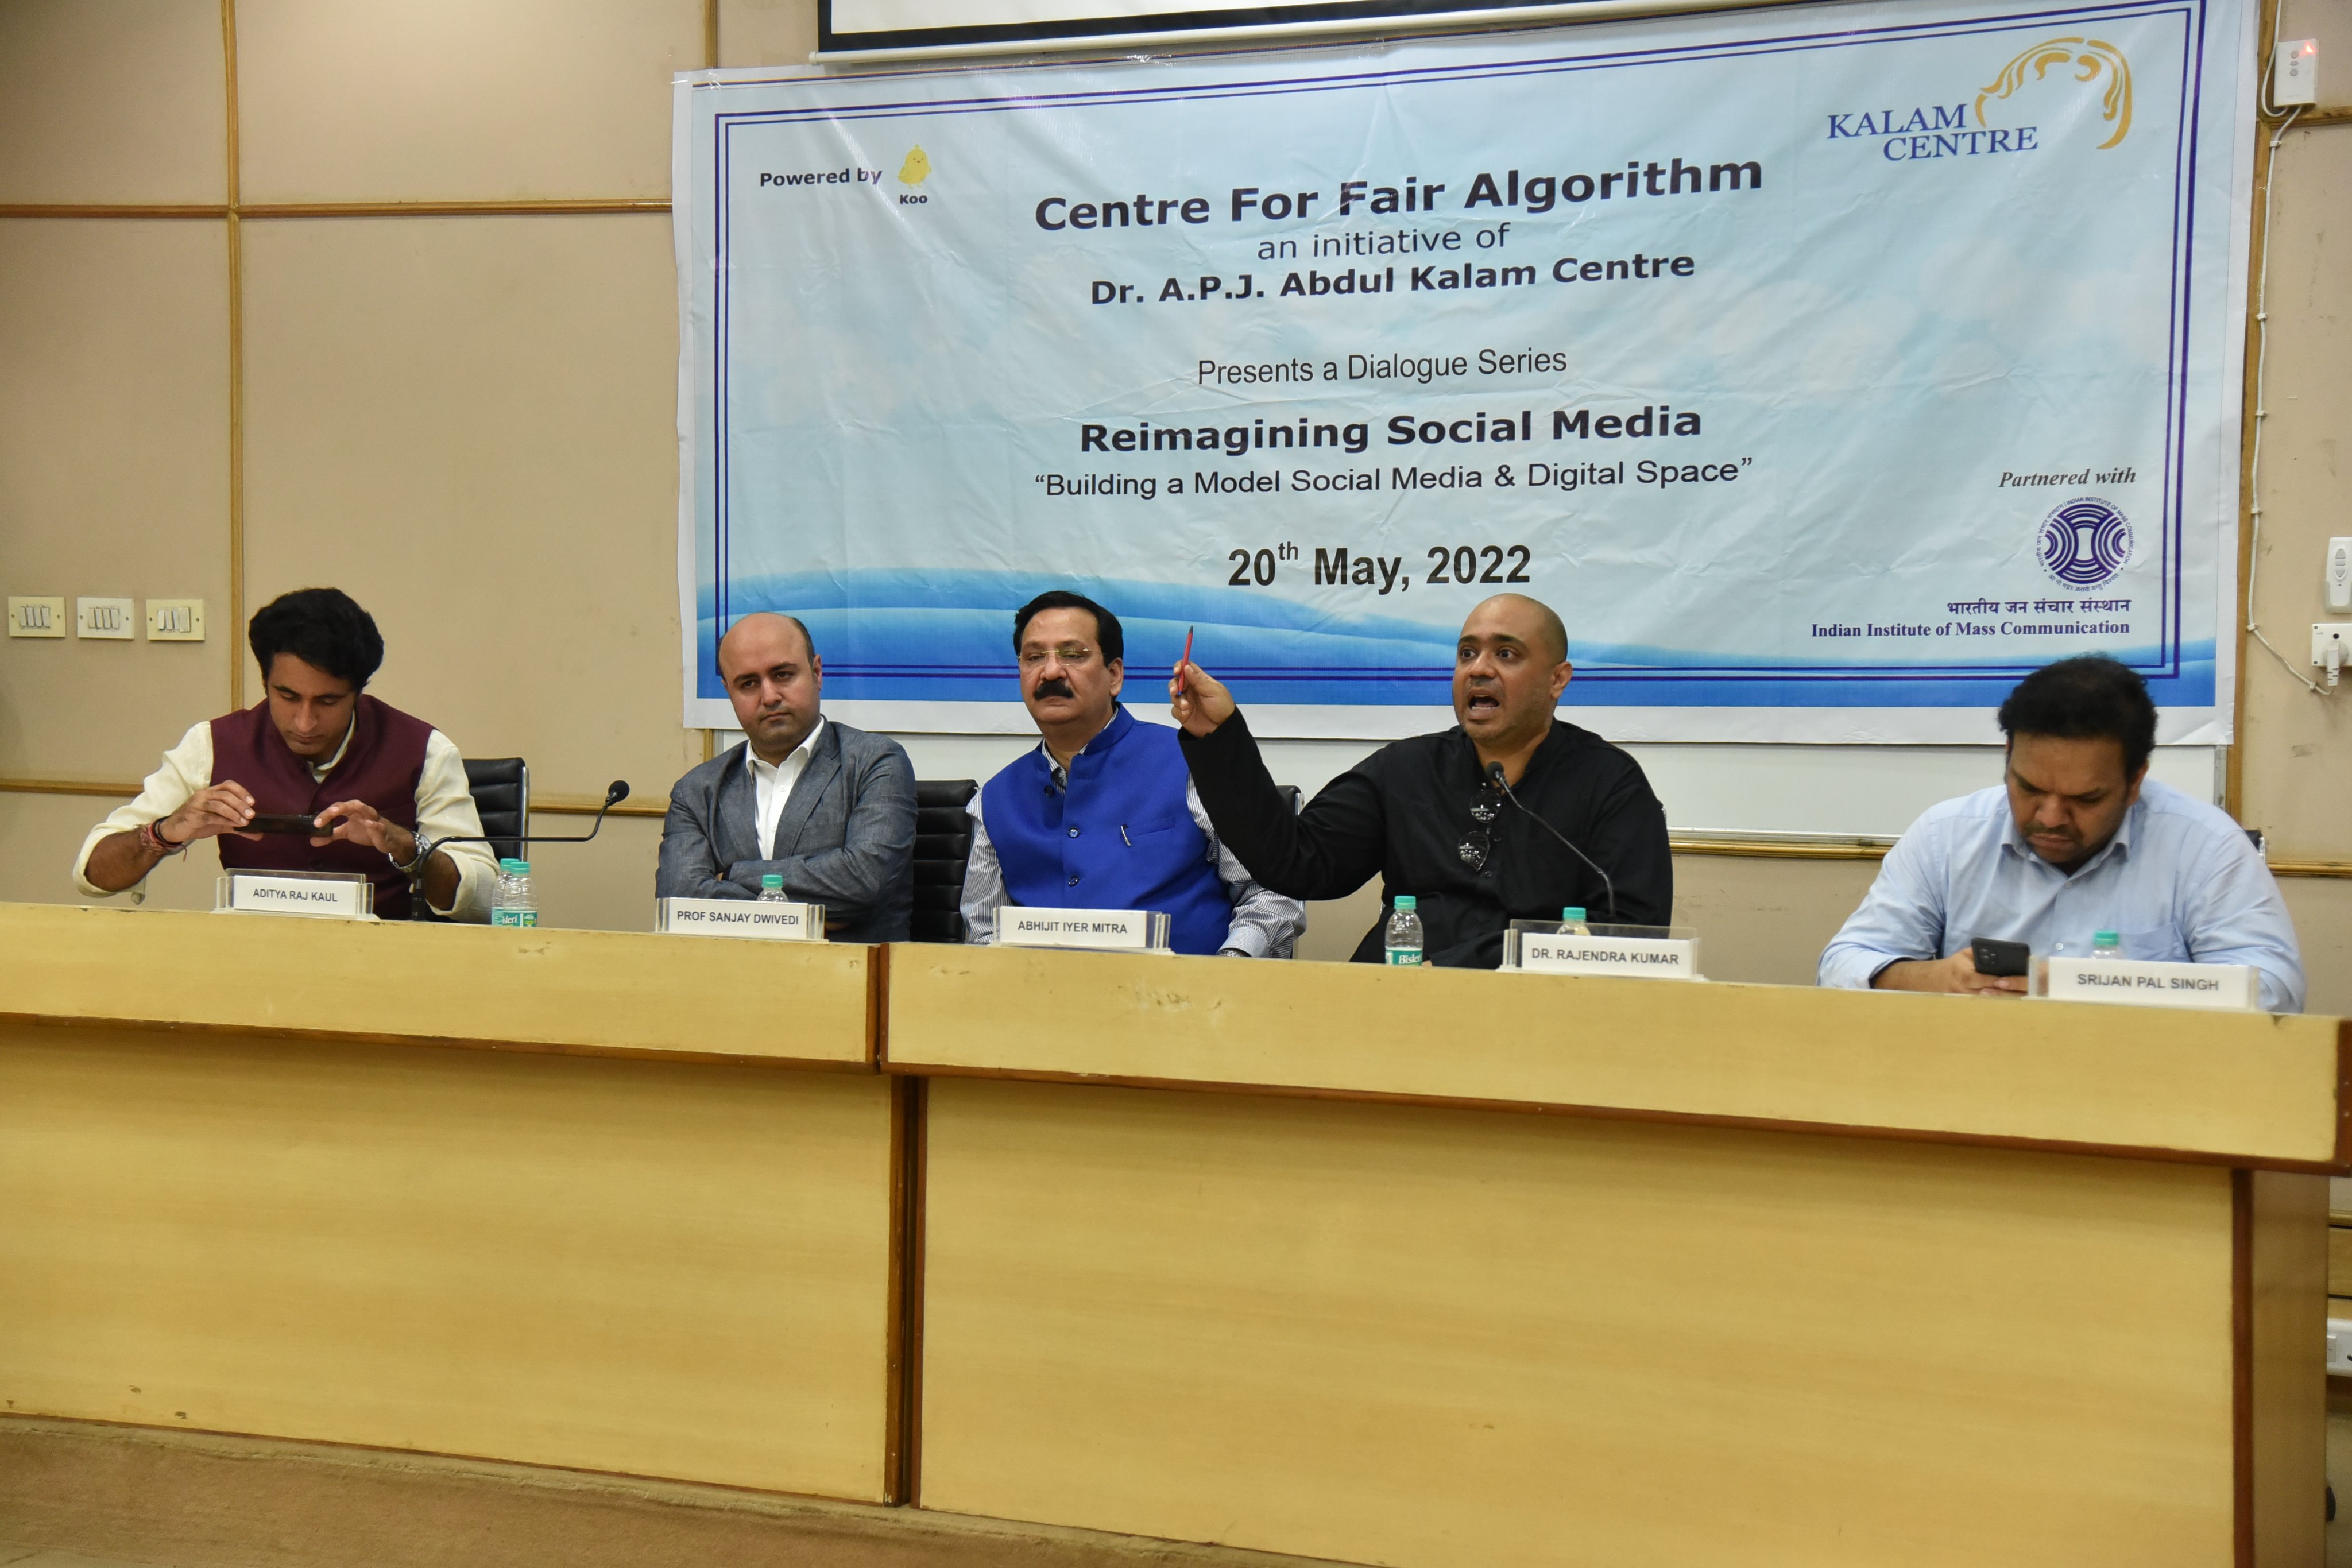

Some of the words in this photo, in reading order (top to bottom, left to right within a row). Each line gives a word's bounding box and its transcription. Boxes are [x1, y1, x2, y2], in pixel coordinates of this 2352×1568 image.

[1827, 103, 1967, 139] KALAM
[1883, 126, 2038, 161] CENTRE
[761, 168, 849, 187] Powered
[857, 168, 882, 184] by
[900, 195, 927, 204] Koo
[1036, 195, 1209, 230] Centre
[1232, 188, 1318, 221] For
[1340, 177, 1445, 215] Fair
[1464, 158, 1761, 213] Algorithm
[1258, 241, 1296, 260] an
[1314, 229, 1461, 257] initiative
[1476, 222, 1511, 248] of
[1092, 281, 1143, 304] Dr.
[1159, 275, 1264, 301] A.P.J.
[1280, 267, 1393, 296] Abdul
[1411, 263, 1535, 291] Kalam
[1553, 254, 1694, 282] Centre
[1199, 358, 1313, 384] Presents
[1324, 362, 1337, 380] a
[1349, 353, 1467, 384] Dialogue
[1479, 347, 1566, 374] Series
[1082, 418, 1368, 456] Reimagining
[1388, 411, 1531, 444] Social
[1554, 406, 1700, 439] Media
[1167, 478, 1183, 494] a
[1196, 471, 1279, 493] Model
[1291, 468, 1379, 491] Social
[1392, 466, 1481, 489] Media
[1495, 465, 1515, 487] &
[1529, 462, 1623, 491] Digital
[1998, 469, 2090, 487] Partnered
[2096, 467, 2136, 483] with
[1315, 548, 1409, 595] May,
[1426, 545, 1530, 584] 2022
[1947, 598, 2000, 614] भारतीय
[2005, 602, 2029, 613] जन
[2033, 598, 2074, 613] संचार
[2079, 597, 2132, 613] संस्थान
[1812, 624, 1860, 636] Indian
[1867, 624, 1931, 636] Institute
[1936, 622, 1952, 636] of
[1956, 622, 1995, 635] Mass
[2001, 620, 2129, 635] Communication
[253, 889, 287, 899] ADITYA
[290, 891, 307, 900] RAJ
[312, 892, 337, 901] KAUL
[678, 911, 706, 920] PROF
[710, 912, 750, 922] SANJAY
[754, 914, 798, 924] DWIVEDI
[1018, 921, 1059, 931] ABHIJIT
[1063, 923, 1088, 932] IYER
[1093, 923, 1127, 933] MITRA
[1533, 948, 1553, 958] DR.
[1557, 950, 1627, 962] RAJENDRA
[1631, 953, 1678, 964] KUMAR
[2078, 974, 2131, 986] SRIJAN
[2137, 977, 2165, 988] PAL
[2171, 978, 2218, 990] SINGH
